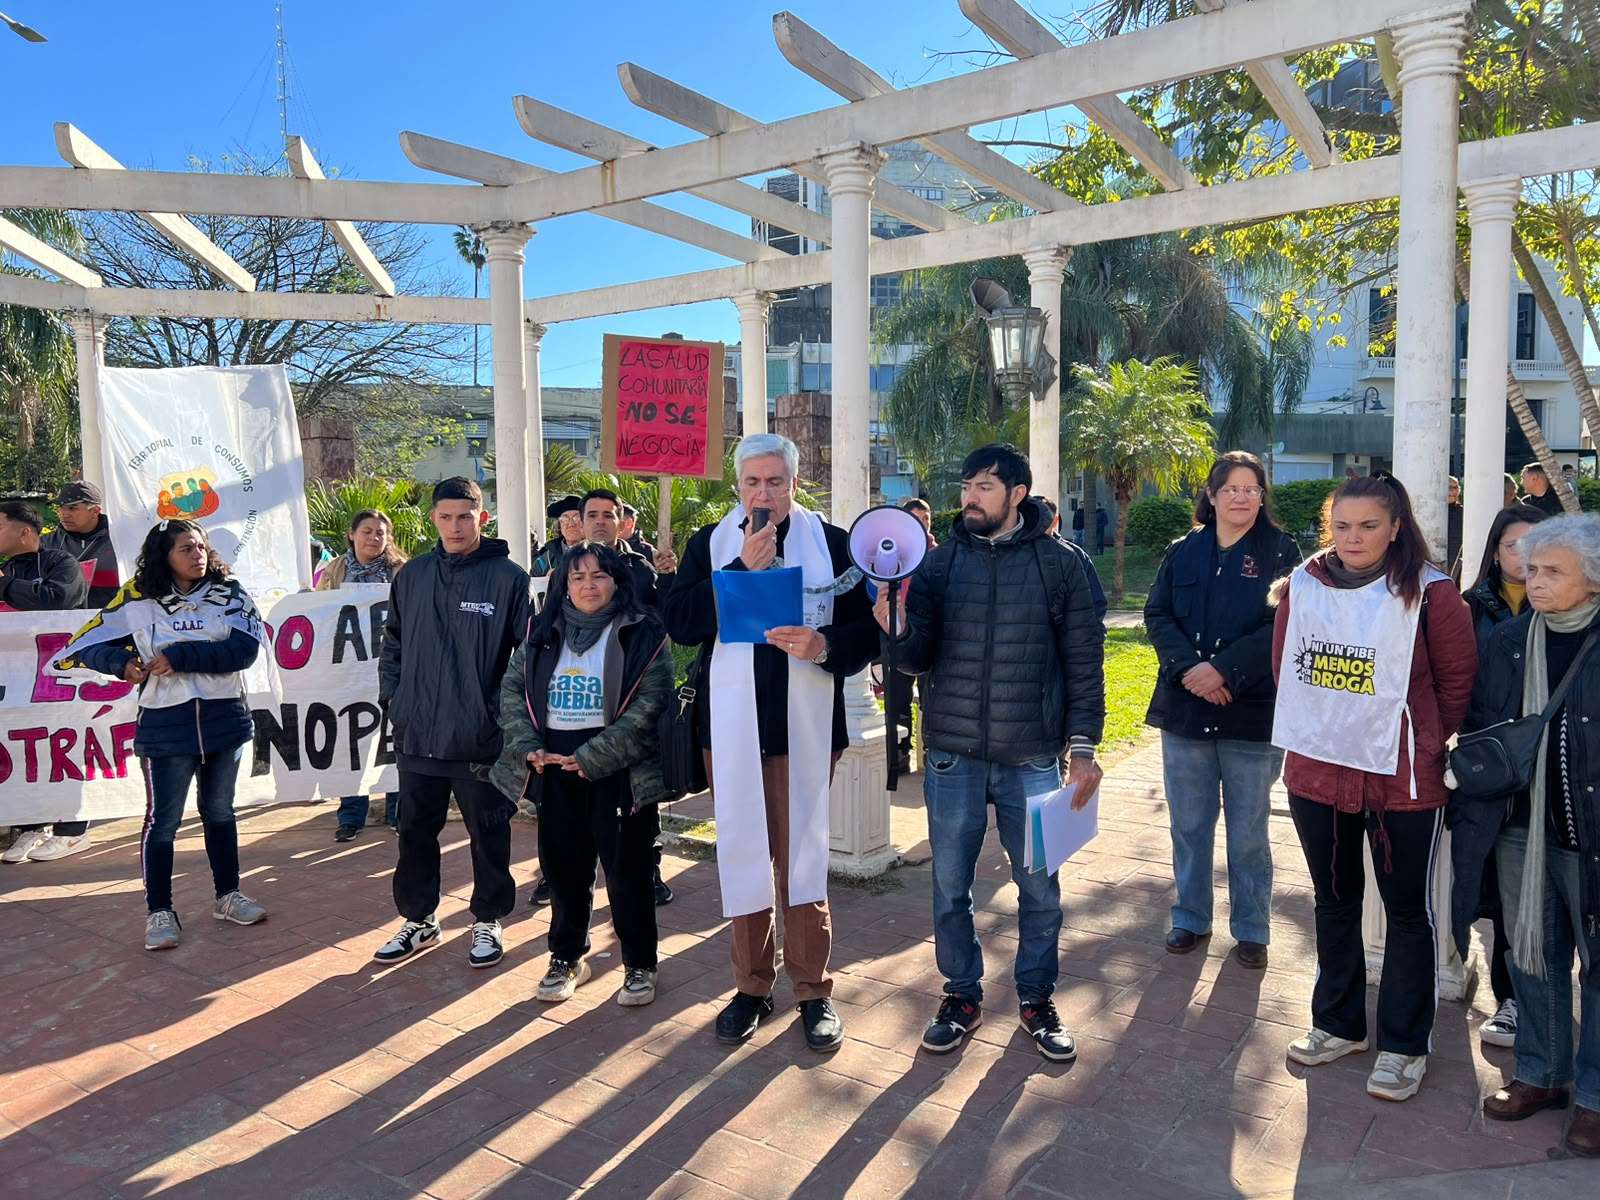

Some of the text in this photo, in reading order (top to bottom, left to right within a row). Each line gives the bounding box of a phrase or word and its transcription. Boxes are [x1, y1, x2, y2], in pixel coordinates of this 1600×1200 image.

[128, 435, 254, 493] TERRTORIAL DE CONSUMOS
[1311, 641, 1375, 660] NI UN PIBE
[1313, 654, 1375, 677] MENOS
[1311, 669, 1375, 695] DROGA
[548, 691, 604, 710] UEBLO
